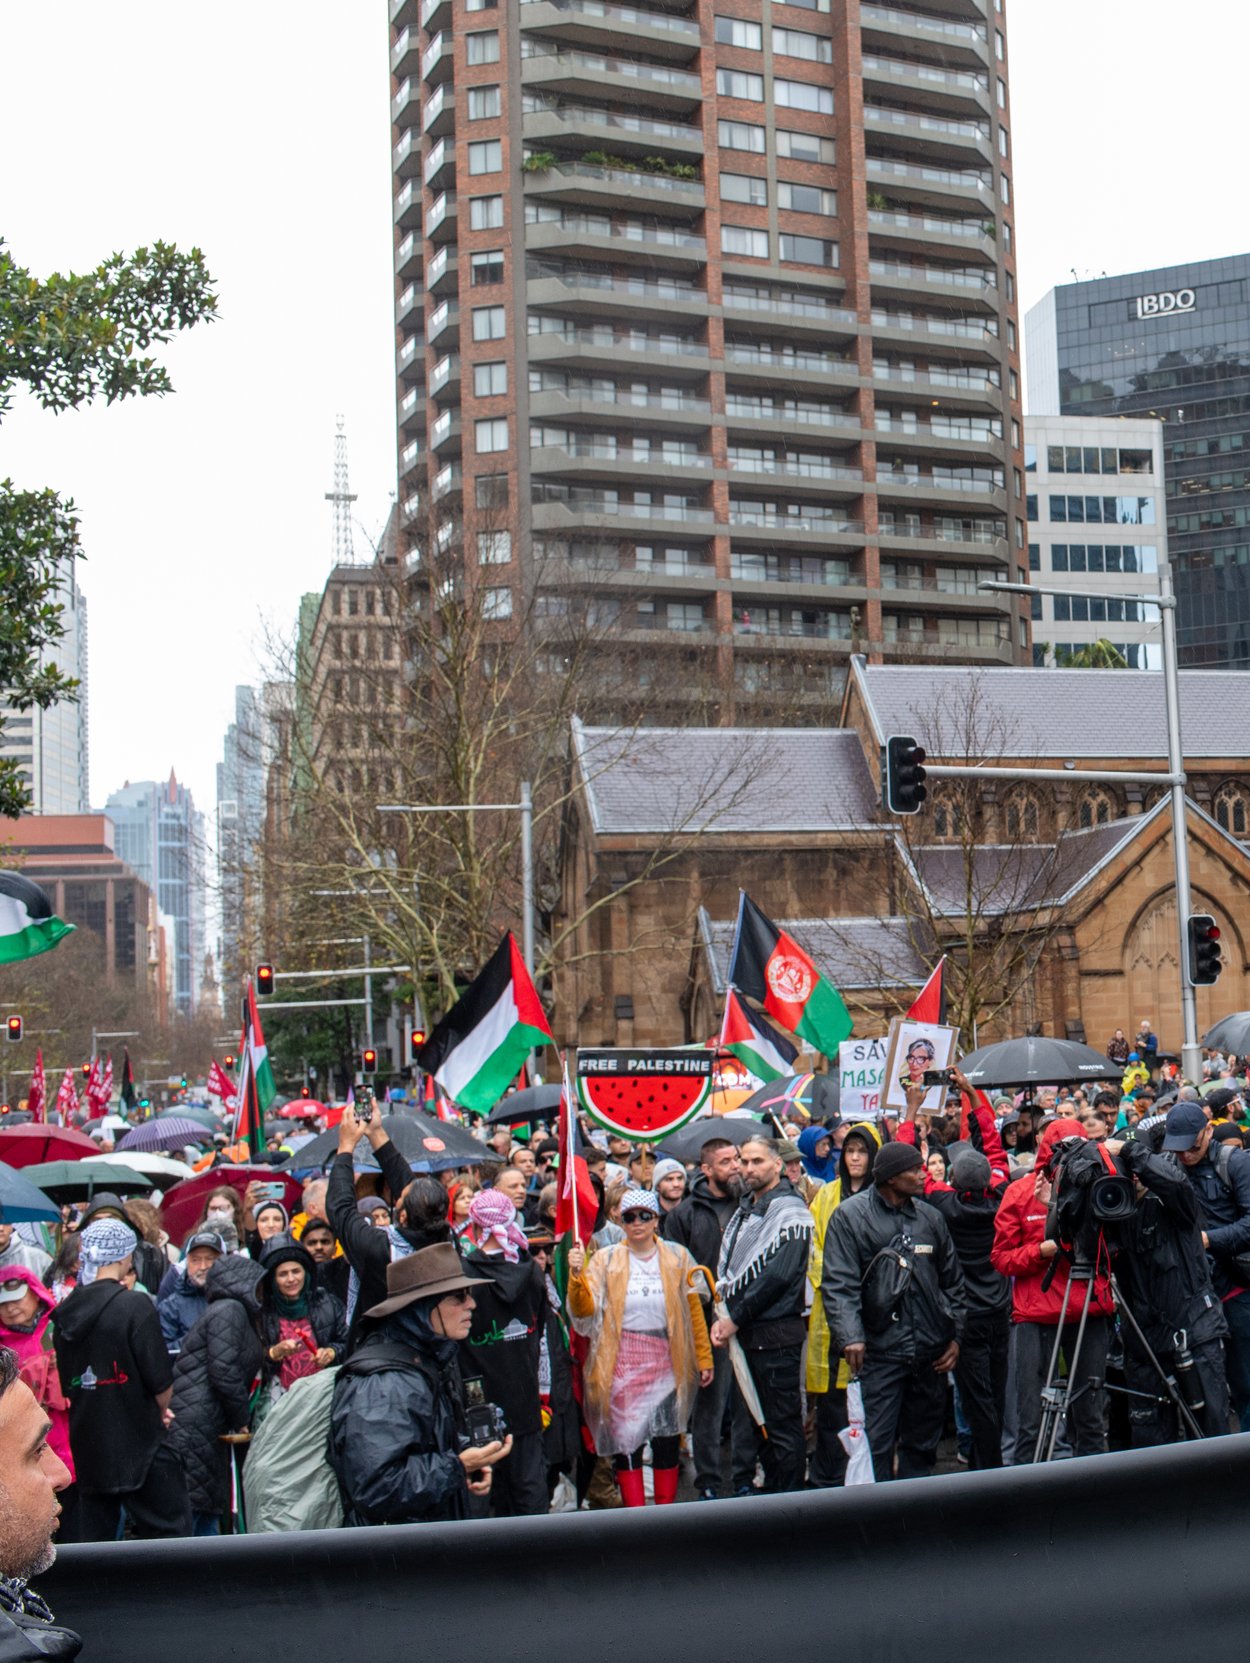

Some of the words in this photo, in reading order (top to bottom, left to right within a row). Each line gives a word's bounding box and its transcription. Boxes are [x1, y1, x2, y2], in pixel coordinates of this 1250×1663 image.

[578, 1059, 617, 1071] FREE
[841, 1068, 886, 1088] MASA
[861, 1093, 879, 1111] YA
